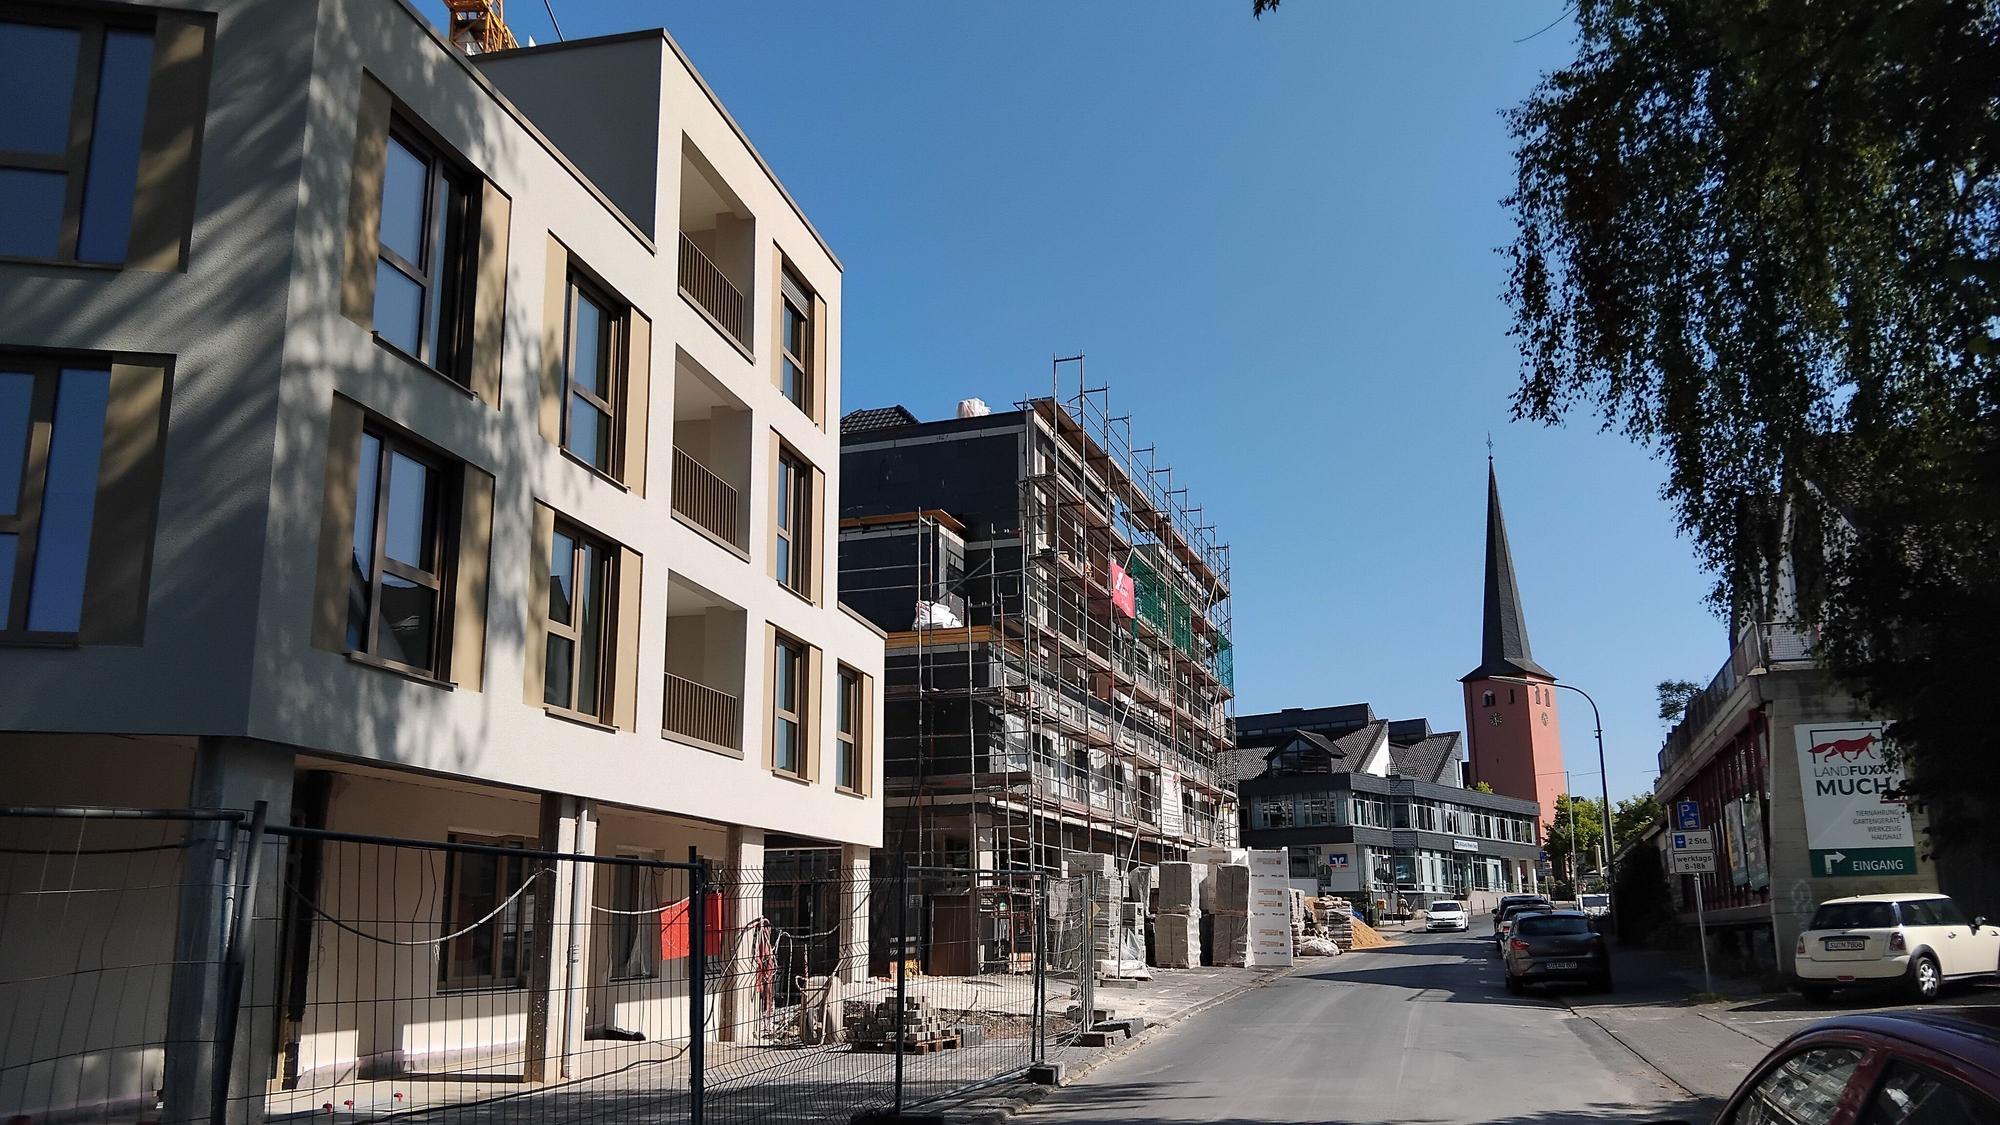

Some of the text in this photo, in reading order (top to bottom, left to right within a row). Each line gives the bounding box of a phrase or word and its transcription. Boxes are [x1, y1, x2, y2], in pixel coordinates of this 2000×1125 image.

[1814, 764, 1888, 777] LANDFUXX
[1816, 777, 1892, 796] MUCH
[1681, 804, 1690, 816] P
[1867, 825, 1902, 833] WERKZEUG
[1871, 833, 1902, 841] HAUSHALT
[1853, 860, 1904, 871] EINGANG
